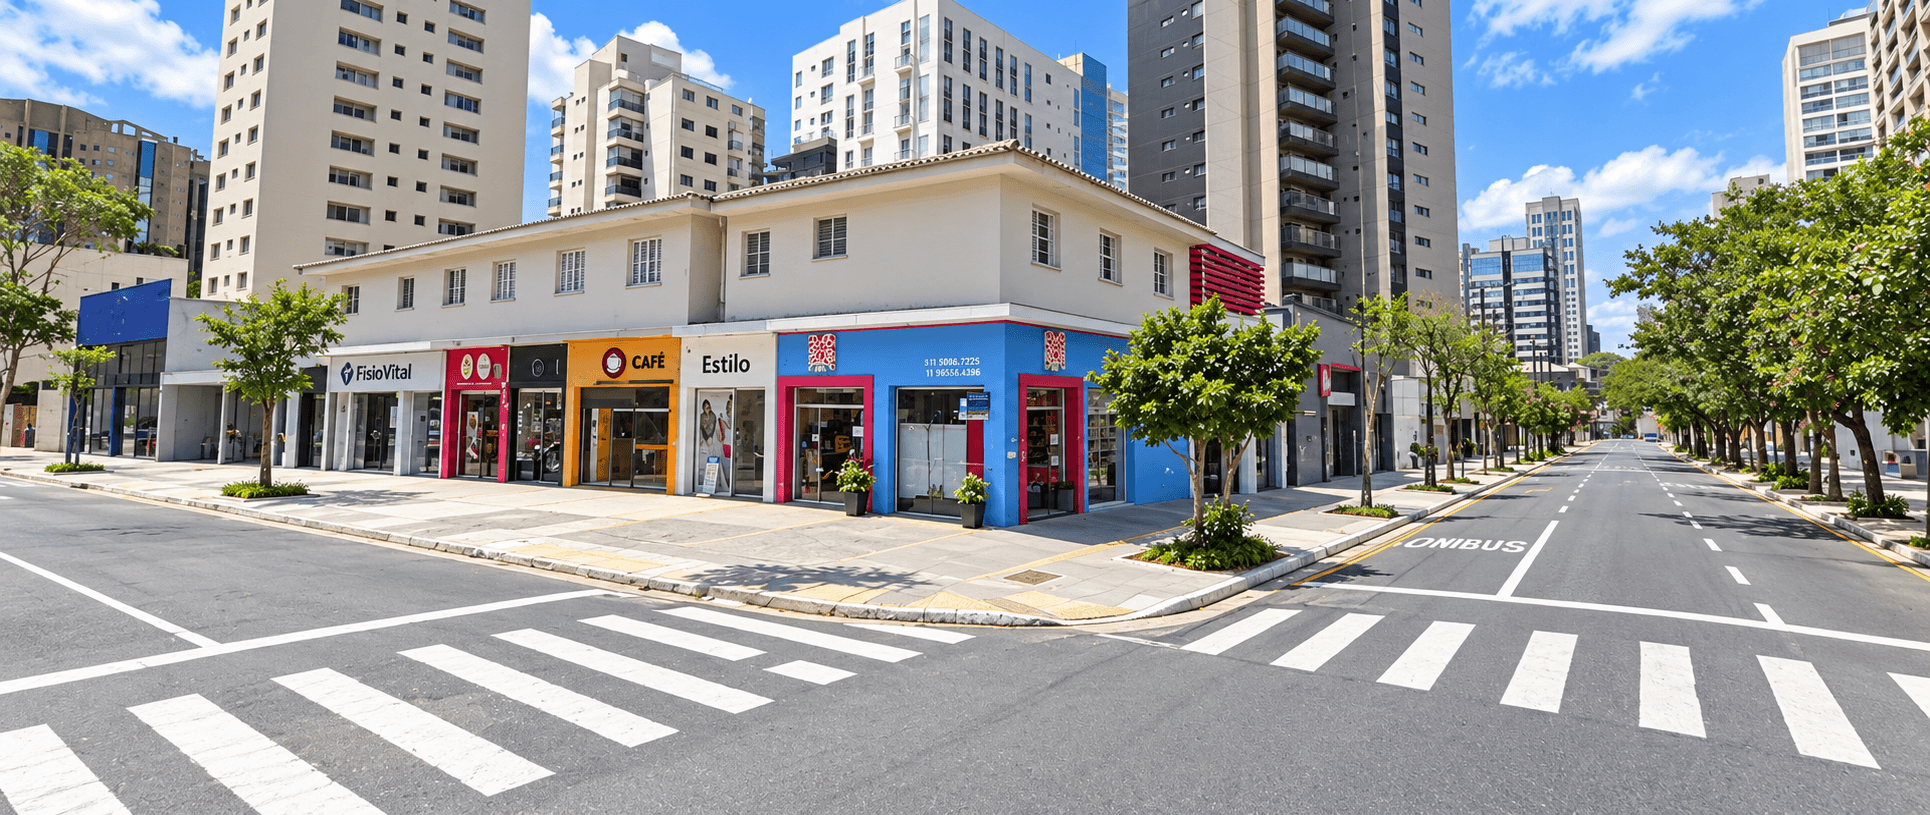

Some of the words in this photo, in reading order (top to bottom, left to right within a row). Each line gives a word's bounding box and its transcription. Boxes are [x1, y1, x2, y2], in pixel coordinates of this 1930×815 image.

[632, 352, 665, 369] CAFÉ
[702, 353, 751, 374] Estilo
[356, 363, 412, 381] FisioVital
[1403, 537, 1528, 553] ONIBUS
